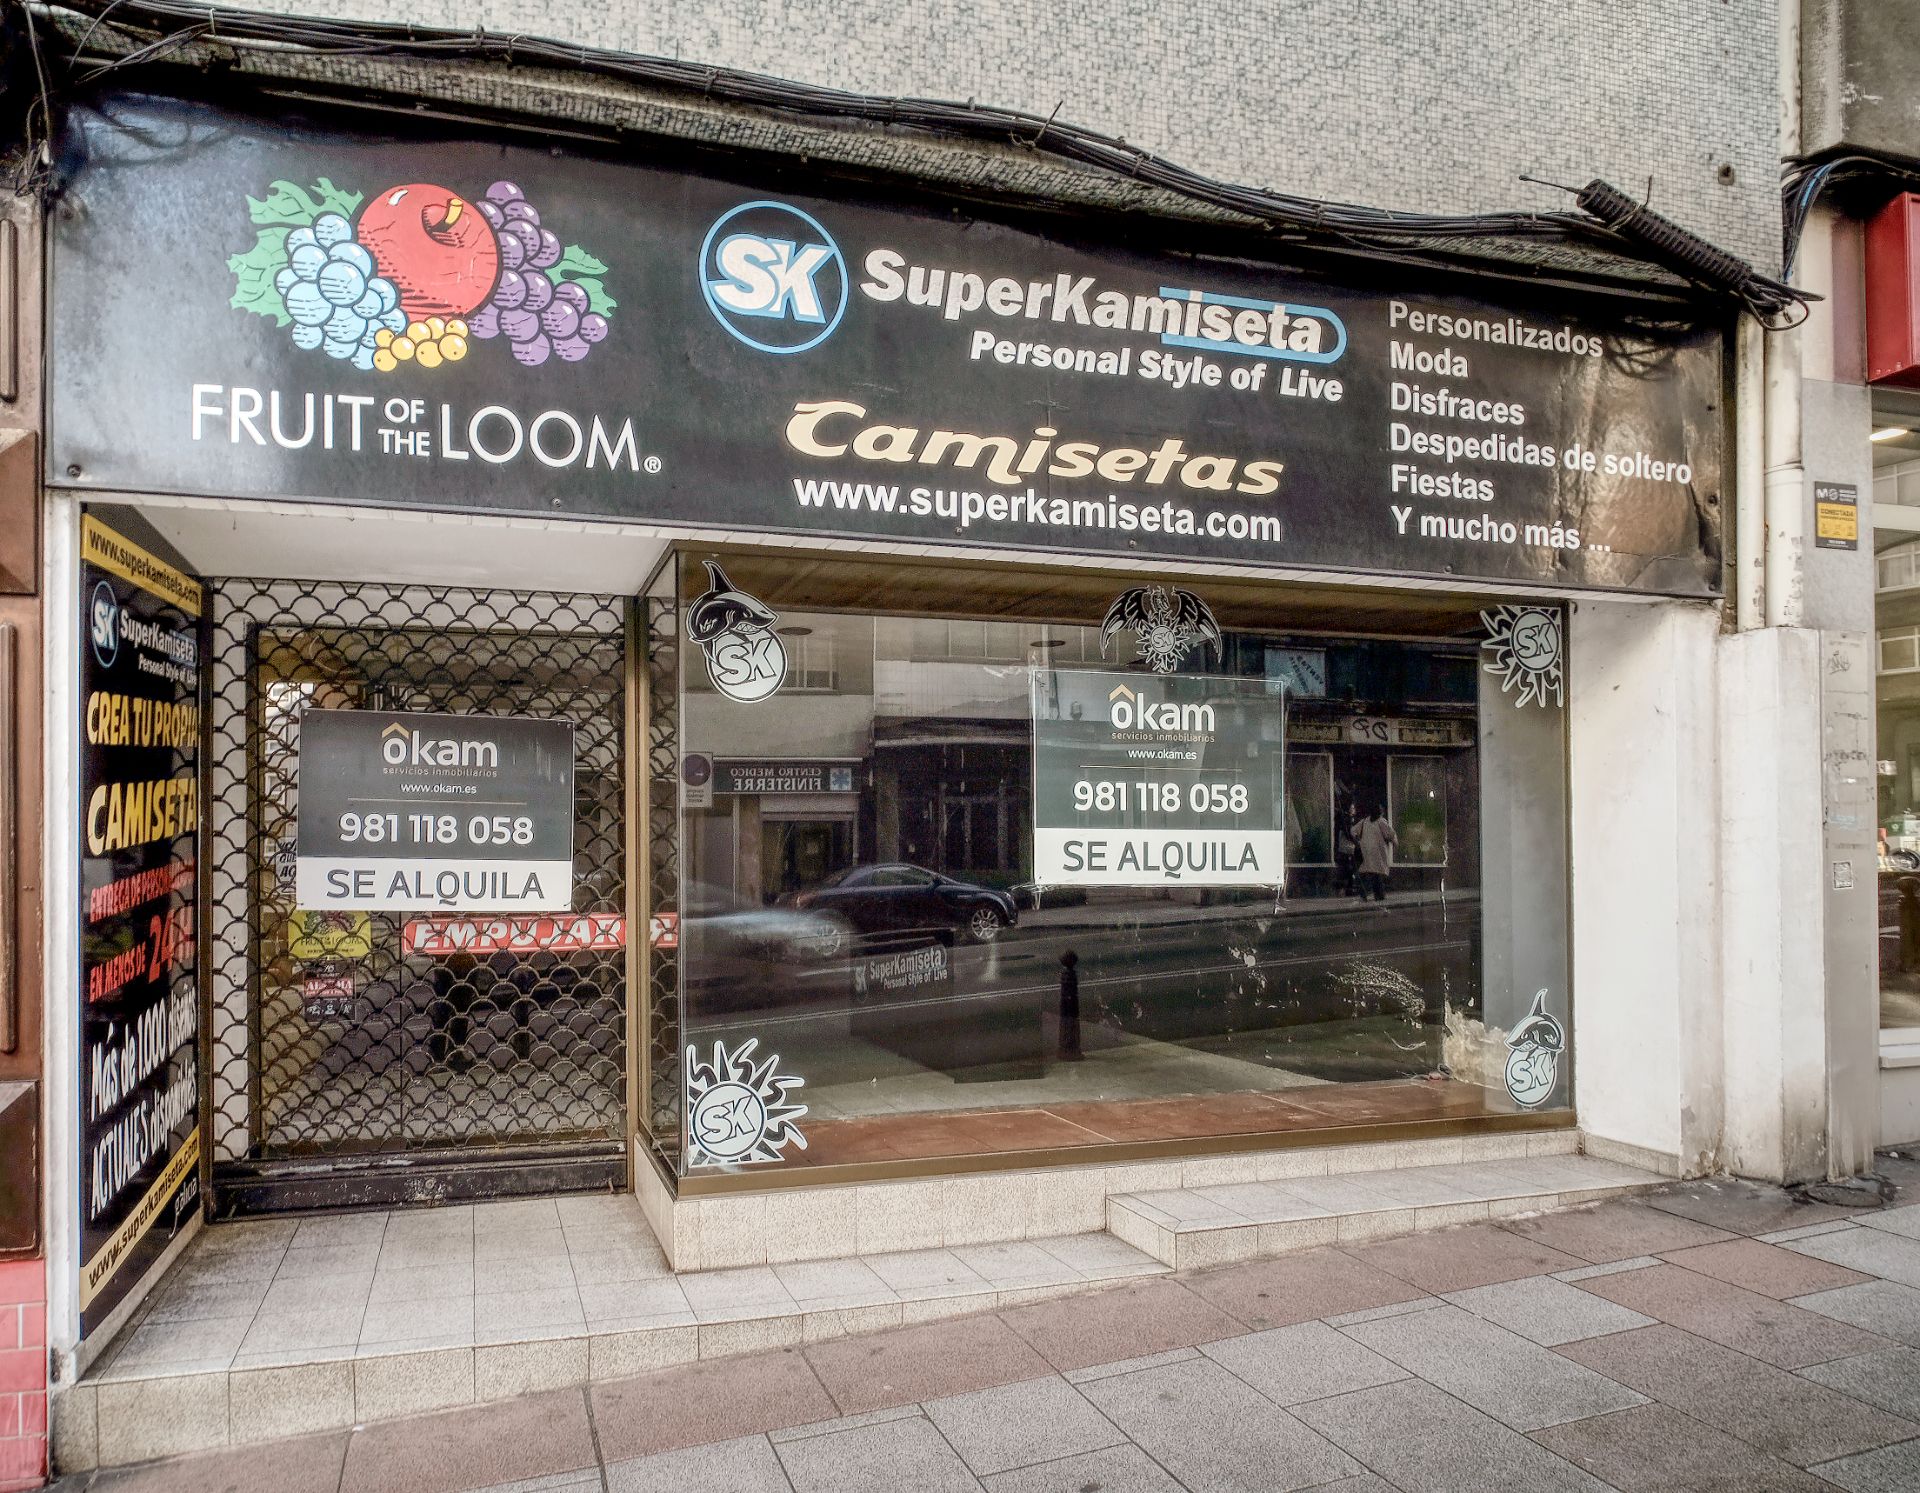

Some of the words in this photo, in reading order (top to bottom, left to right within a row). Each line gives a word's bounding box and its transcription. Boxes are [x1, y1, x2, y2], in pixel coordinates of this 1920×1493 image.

[709, 233, 837, 324] SK
[860, 249, 1322, 354] SuperKamiseta
[1389, 300, 1603, 357] Personalizados
[970, 330, 1131, 377] Personal
[1137, 349, 1223, 390] Style
[1229, 363, 1267, 392] of
[1280, 367, 1344, 402] Live
[1390, 341, 1468, 378] Moda
[191, 383, 374, 451] FRUIT
[384, 398, 425, 424] OF
[1390, 382, 1525, 425] Disfraces
[377, 428, 430, 457] THE
[785, 400, 1284, 496] Camisetas
[1390, 423, 1556, 467] Despedidas
[1563, 443, 1596, 472] de
[1604, 451, 1692, 485] soltero
[1391, 464, 1495, 502] Fiestas
[793, 478, 1282, 542] www.superkamiseta.com
[1390, 505, 1413, 535] Y
[1421, 513, 1517, 545] mucho
[1524, 520, 1580, 550] más
[89, 529, 200, 606] www.superkamiseta.com
[93, 600, 117, 650] SK
[120, 609, 195, 661] SuperKamiseta
[1515, 622, 1555, 659] SK
[715, 636, 777, 686] SK
[87, 691, 130, 745] CREA
[133, 697, 150, 747] TU
[154, 701, 198, 748] PROPIA
[1111, 731, 1153, 741] servicios
[1156, 732, 1215, 743] inmobiliarios
[383, 766, 429, 776] servicios
[432, 766, 498, 778] inmobiliarios
[1128, 748, 1197, 760] www.okam.es
[400, 783, 477, 795] www.okam.es
[1073, 780, 1127, 811] 981
[1136, 782, 1181, 812] 118
[1189, 783, 1249, 814] 058
[87, 777, 198, 856] CAMISETA
[339, 812, 398, 842] 981
[408, 814, 458, 844] 118
[468, 815, 534, 845] 058
[1062, 840, 1107, 872] SE
[1117, 841, 1260, 879] ALQUILA
[326, 869, 376, 899] SE
[386, 870, 545, 906] ALQUILA
[413, 918, 621, 948] EMPUJAR
[90, 963, 104, 1003] EN
[105, 948, 135, 997] MENOS
[136, 941, 147, 976] DE
[870, 948, 941, 982] SuperKamiseta
[90, 1022, 118, 1122] Más
[120, 1023, 136, 1092] de
[137, 997, 167, 1080] 1.000
[1510, 1051, 1549, 1093] SK
[90, 1100, 149, 1222] ACTUALES
[150, 1057, 197, 1156] disponibles
[700, 1094, 756, 1144] SK
[89, 1138, 199, 1290] www.superkamiseta.com
